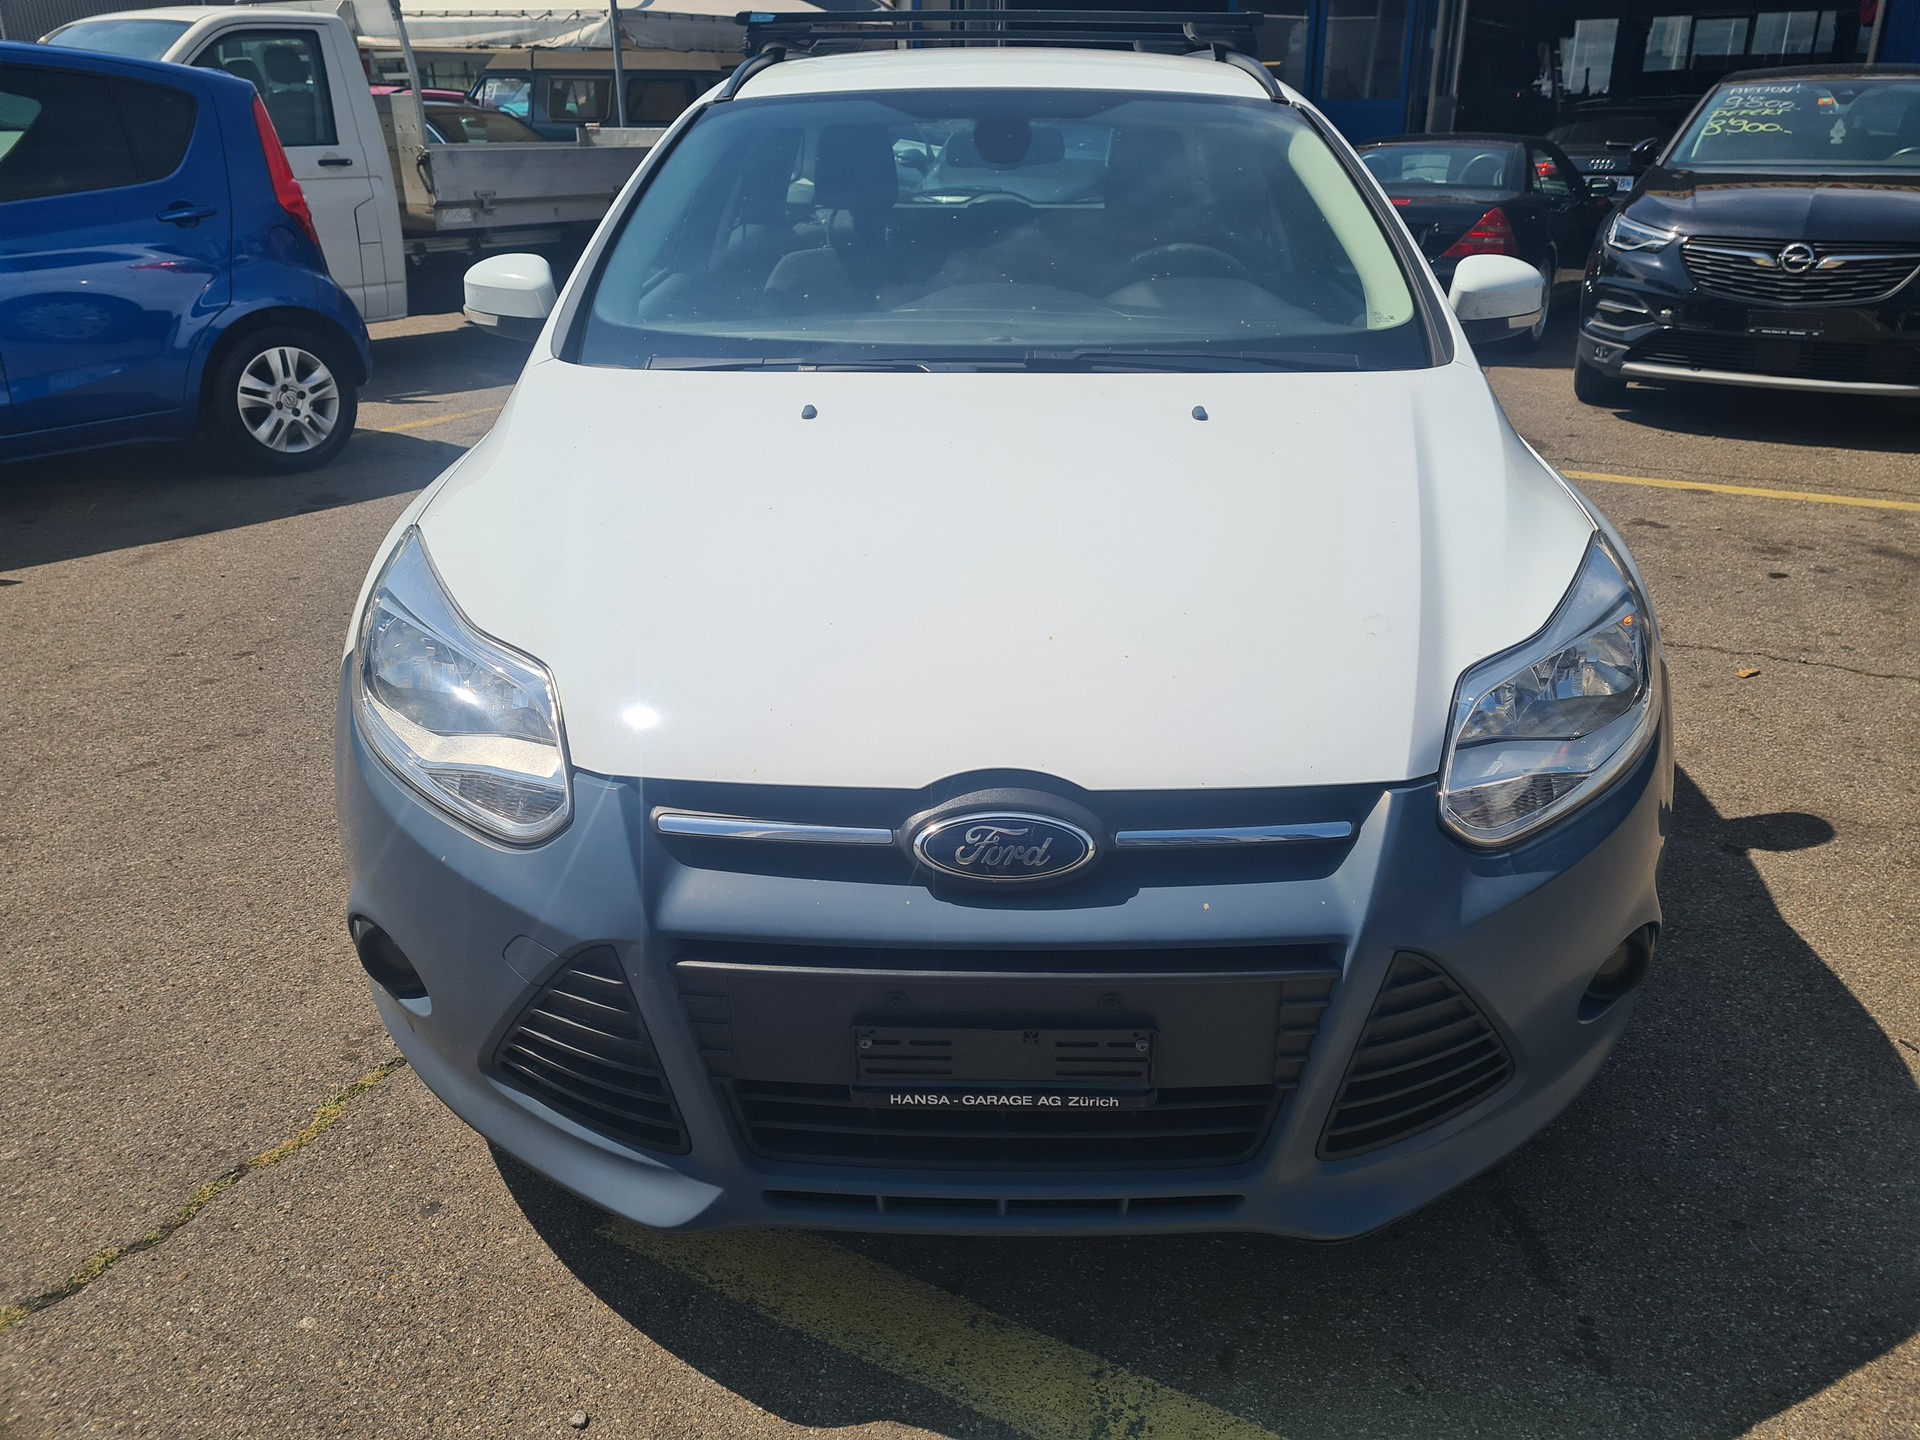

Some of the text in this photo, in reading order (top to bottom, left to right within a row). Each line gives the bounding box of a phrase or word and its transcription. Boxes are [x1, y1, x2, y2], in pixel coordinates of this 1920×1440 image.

[955, 825, 1053, 867] Ford
[890, 1094, 951, 1105] HANSA
[962, 1095, 1033, 1106] GARAGE
[1037, 1095, 1061, 1106] AG
[1068, 1096, 1119, 1107] Zürich
